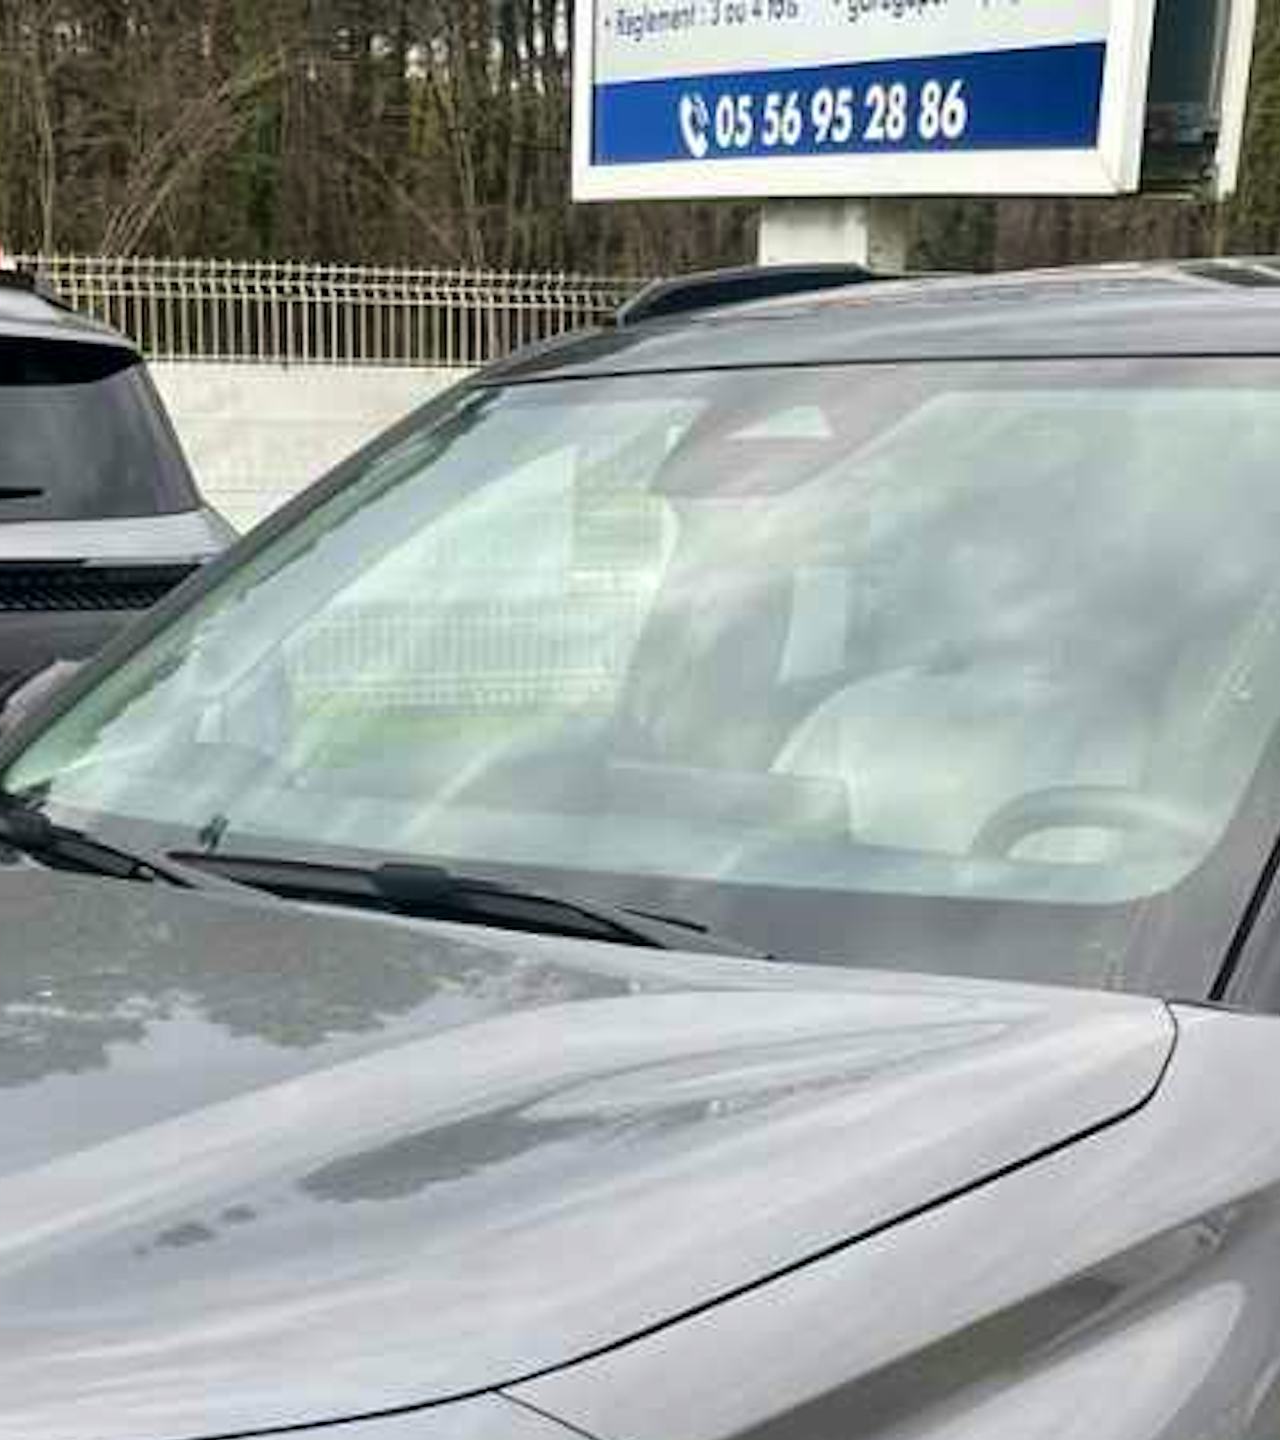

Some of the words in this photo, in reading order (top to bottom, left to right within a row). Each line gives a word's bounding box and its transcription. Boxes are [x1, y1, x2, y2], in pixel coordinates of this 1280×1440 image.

[708, 0, 721, 26] 3
[715, 94, 754, 149] 05
[762, 90, 803, 147] 56
[811, 87, 854, 144] 95
[863, 83, 908, 141] 28
[918, 78, 968, 140] 86
